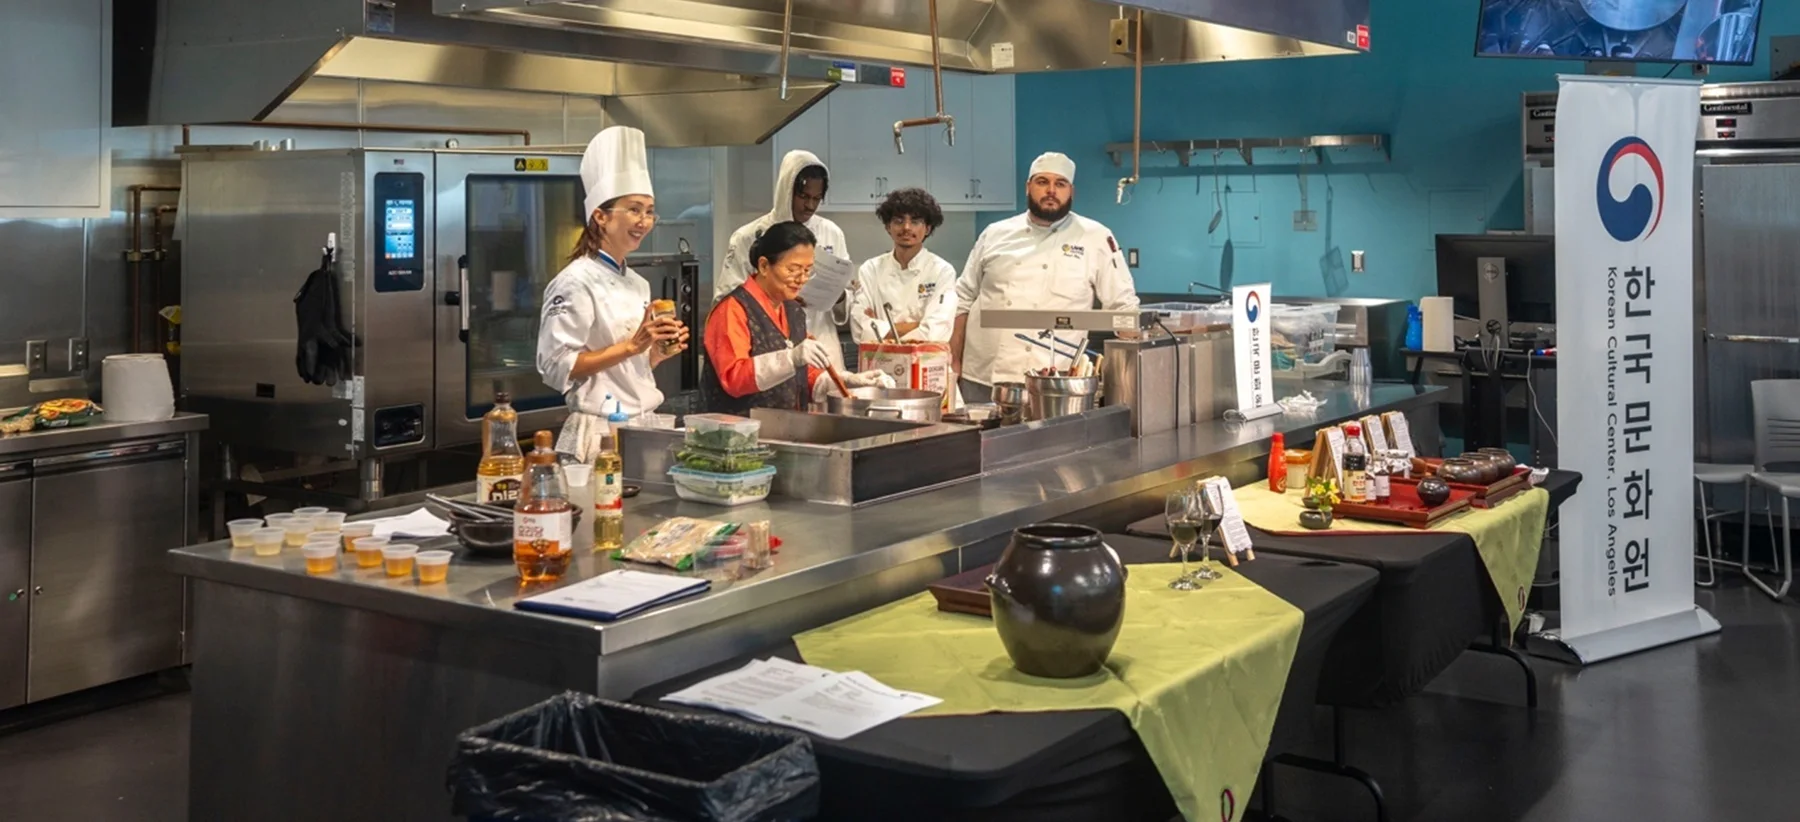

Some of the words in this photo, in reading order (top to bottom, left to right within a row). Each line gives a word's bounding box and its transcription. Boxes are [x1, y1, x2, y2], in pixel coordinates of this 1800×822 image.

[1703, 103, 1748, 112] Continental
[1607, 267, 1618, 330] Korean
[1607, 336, 1618, 406] Cultural
[1622, 266, 1655, 593] 한국문화원
[1607, 487, 1617, 518] Los
[1606, 524, 1618, 597] Angeles
